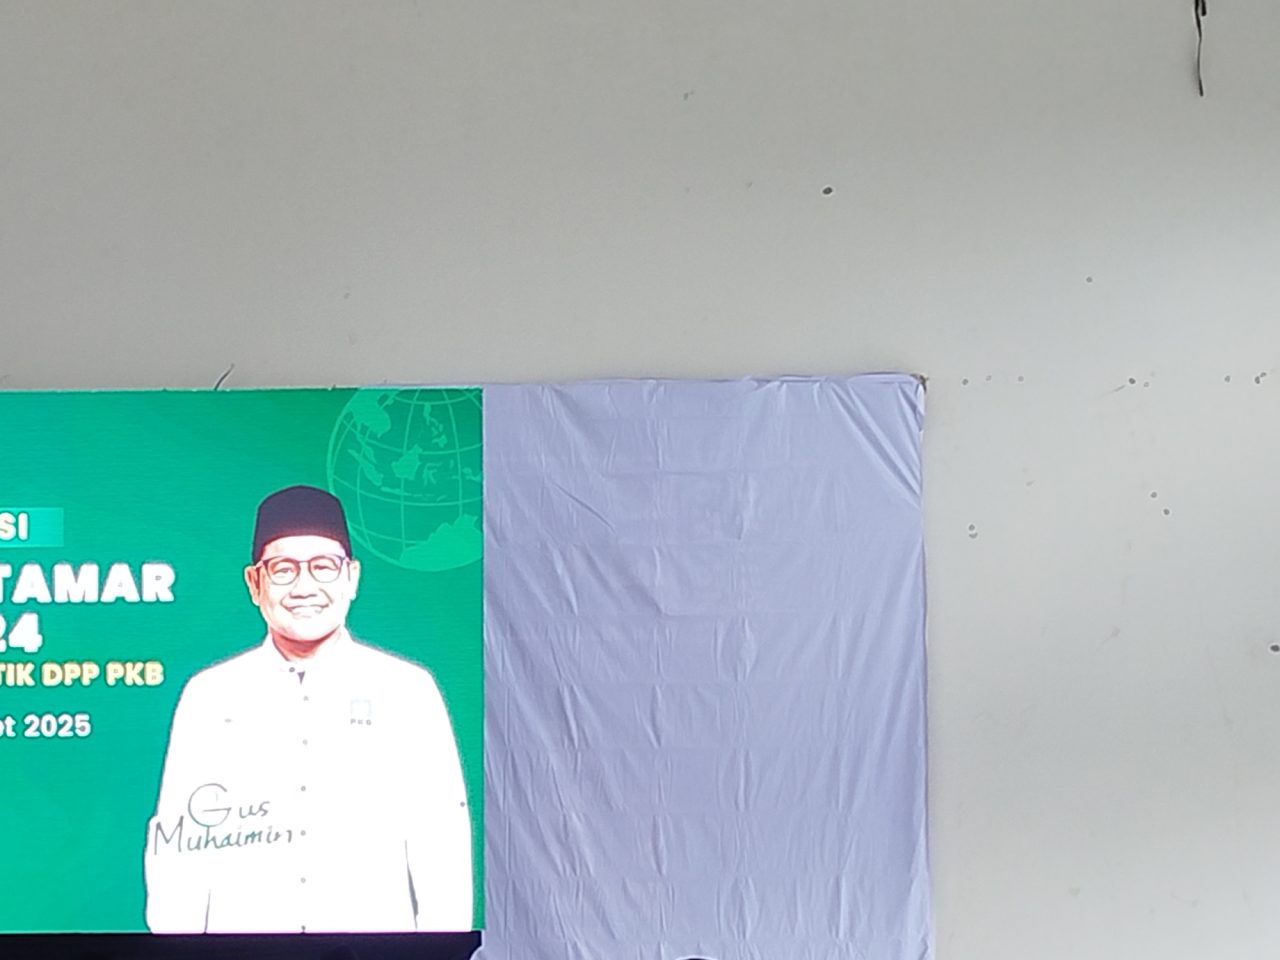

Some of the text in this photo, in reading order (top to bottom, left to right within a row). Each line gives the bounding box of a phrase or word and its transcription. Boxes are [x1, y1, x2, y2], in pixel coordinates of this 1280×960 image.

[41, 661, 99, 687] DPP
[106, 661, 165, 686] PKB
[23, 712, 91, 737] 2025
[188, 783, 270, 828] Gus
[154, 815, 292, 856] Muhaimin
